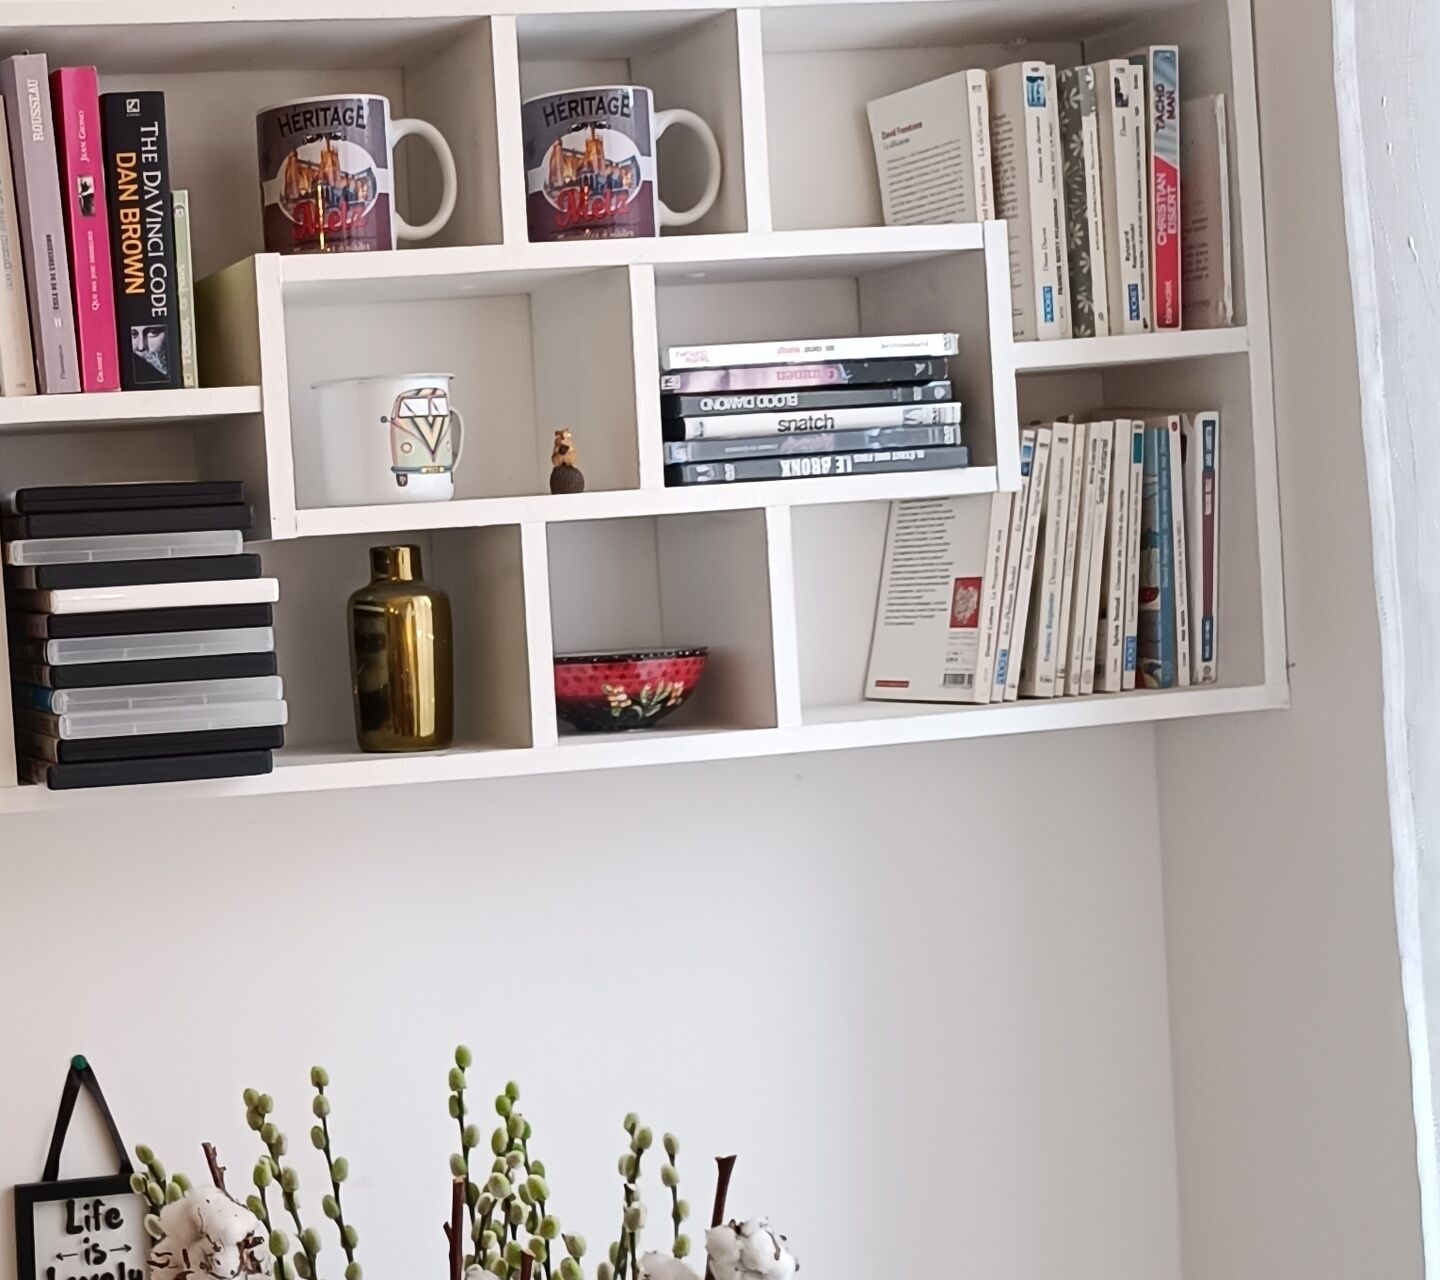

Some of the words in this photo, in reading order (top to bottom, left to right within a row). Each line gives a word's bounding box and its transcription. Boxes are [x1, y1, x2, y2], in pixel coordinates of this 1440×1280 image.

[26, 78, 45, 142] ROUSSEAU
[278, 105, 367, 138] HÉRITAGE
[140, 121, 160, 163] THE
[116, 151, 139, 201] DAN
[1157, 172, 1167, 246] CHRISTIAN
[1167, 185, 1177, 235] EISERT
[119, 207, 146, 295] BROWN
[149, 262, 168, 318] CODE
[700, 395, 755, 411] DIAMOND
[757, 392, 799, 408] BLOOD
[777, 413, 835, 433] snatch
[65, 1199, 124, 1234] Life
[83, 1236, 107, 1265] is
